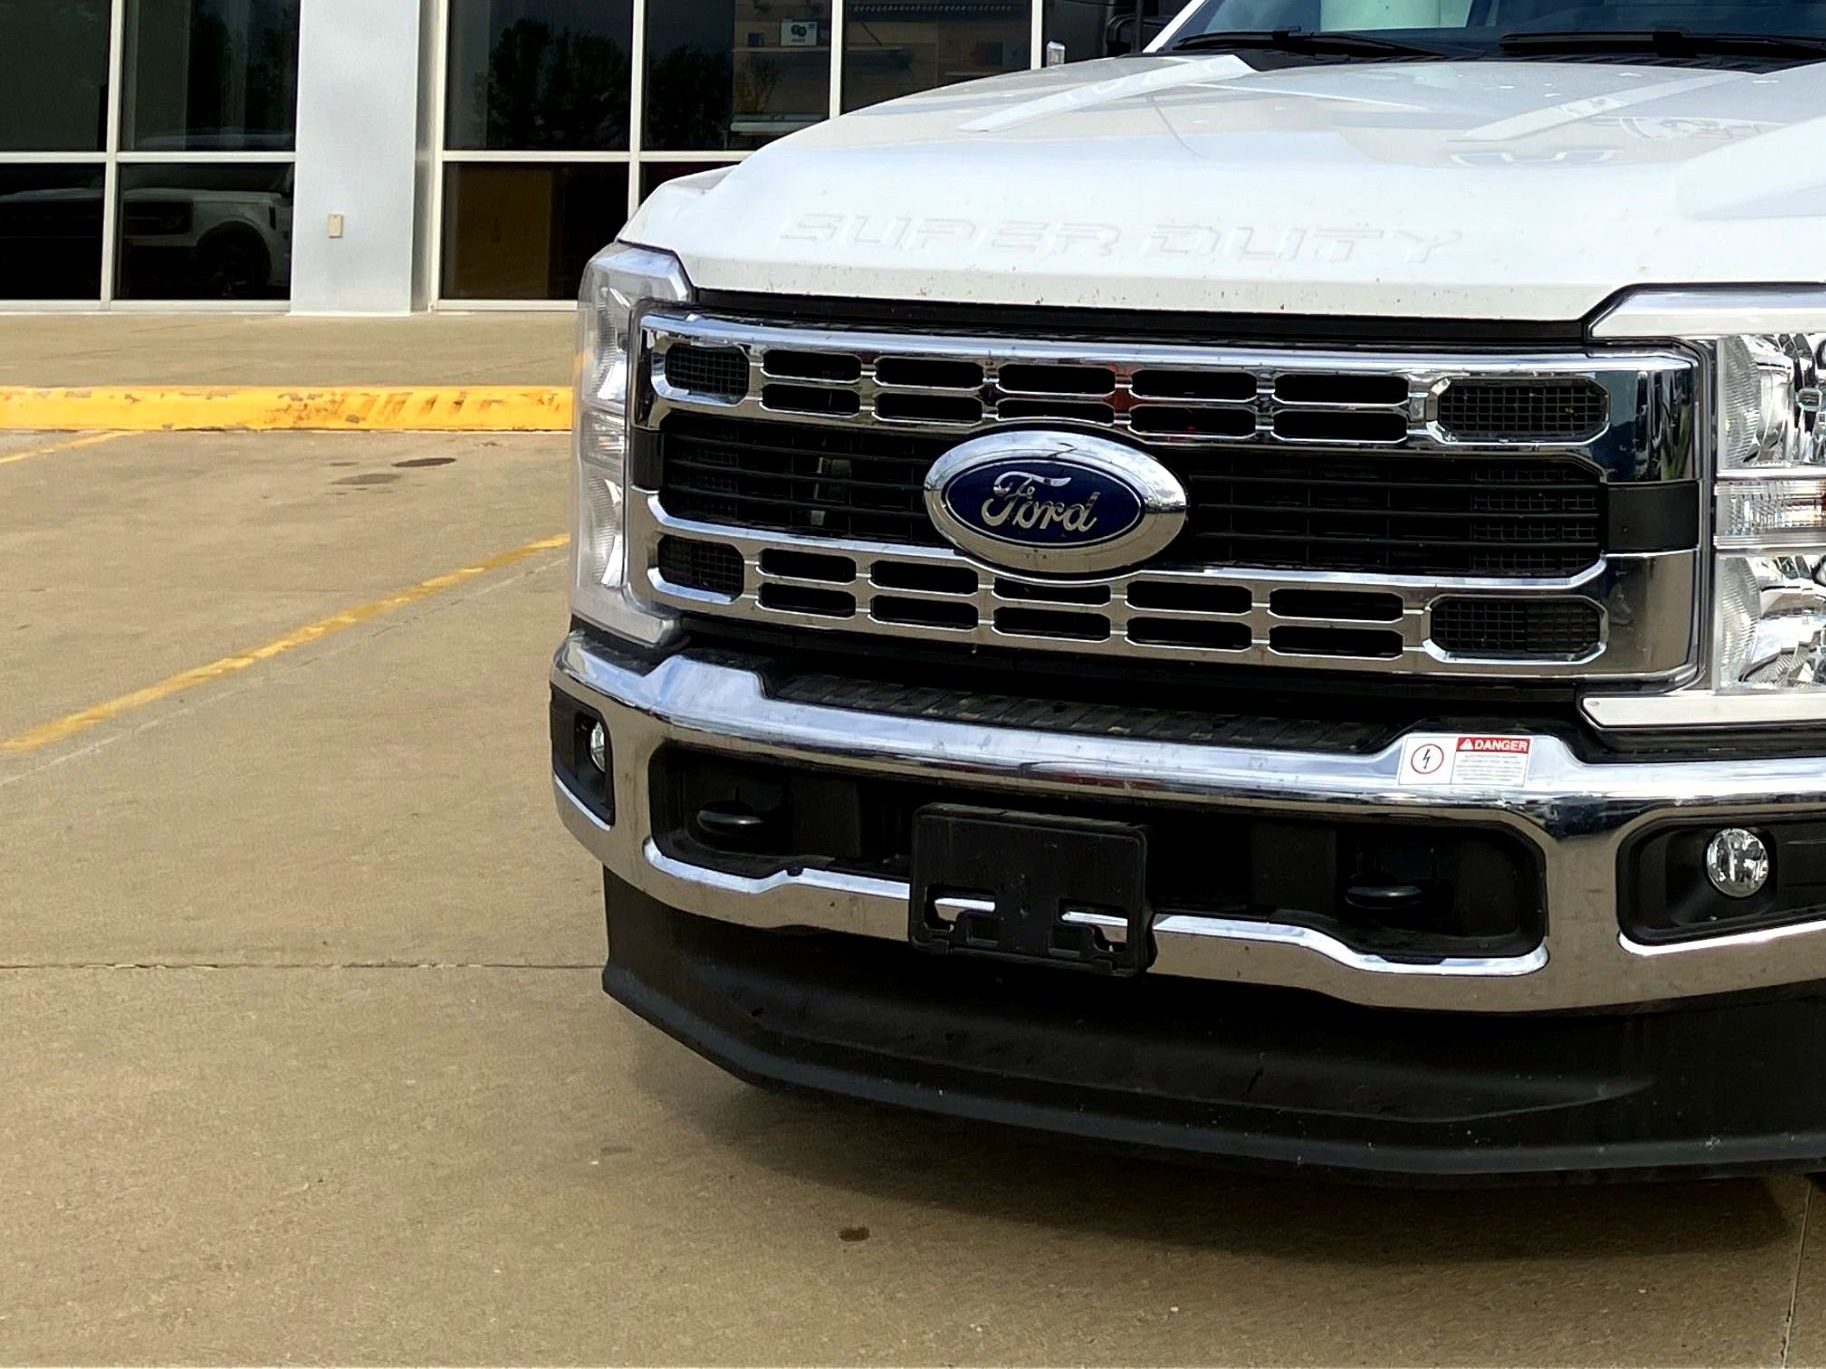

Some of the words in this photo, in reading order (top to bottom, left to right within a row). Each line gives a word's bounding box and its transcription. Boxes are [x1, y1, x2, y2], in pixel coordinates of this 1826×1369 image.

[780, 212, 1121, 256] SUPER
[1142, 222, 1464, 264] DUTY
[981, 470, 1101, 533] Ford
[1474, 739, 1528, 752] DANGER
